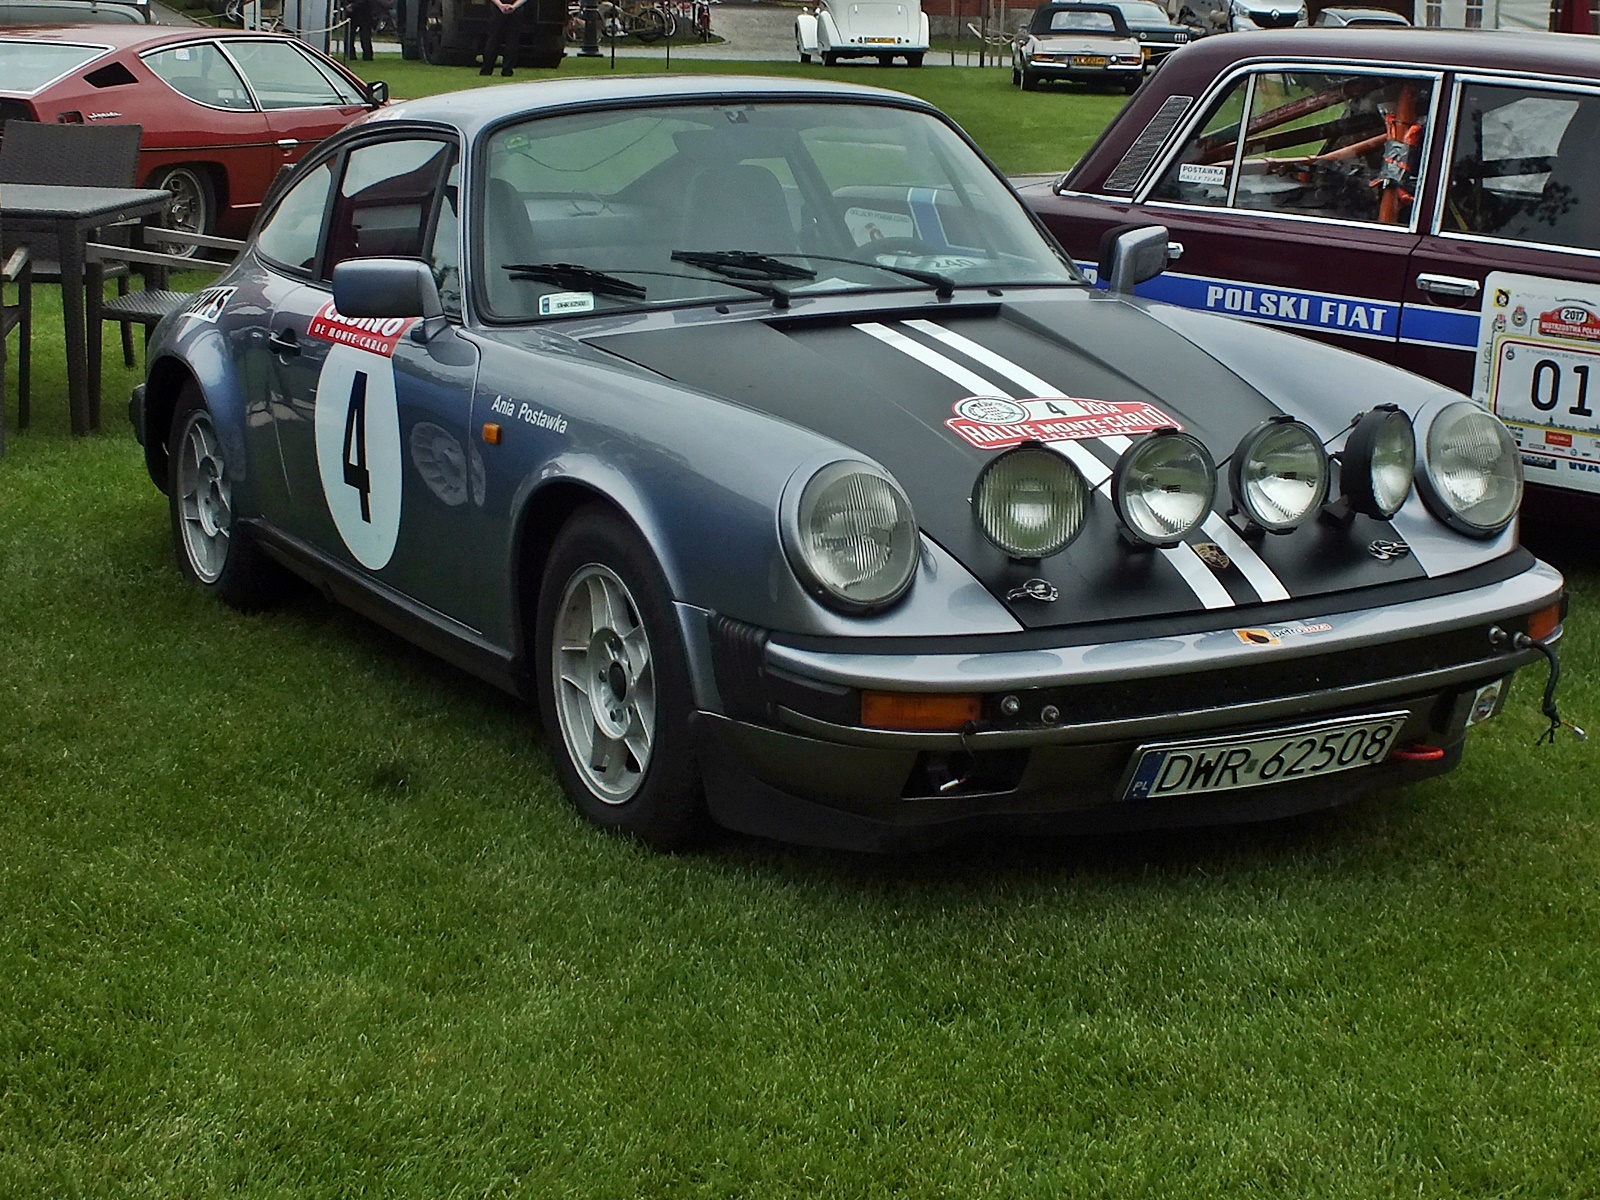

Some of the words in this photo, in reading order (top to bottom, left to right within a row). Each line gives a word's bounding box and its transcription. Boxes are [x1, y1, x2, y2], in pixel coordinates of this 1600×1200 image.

[1182, 165, 1224, 175] POSTAWKA
[1206, 285, 1310, 321] POLSKI
[1319, 301, 1388, 332] FIAT
[1564, 309, 1585, 321] 2017
[314, 323, 326, 335] DE
[327, 327, 389, 354] MONTE-CARLO
[1531, 359, 1593, 418] 01
[491, 394, 515, 417] Ania
[517, 402, 568, 434] Postawka
[1049, 401, 1068, 416] 4
[1078, 401, 1123, 415] 2014
[958, 424, 1041, 443] RALLYE
[1037, 408, 1170, 434] MONTE-CARLO
[343, 370, 372, 524] 4
[1154, 748, 1252, 793] DWR
[1259, 725, 1395, 780] 62508
[1132, 780, 1149, 792] PL
